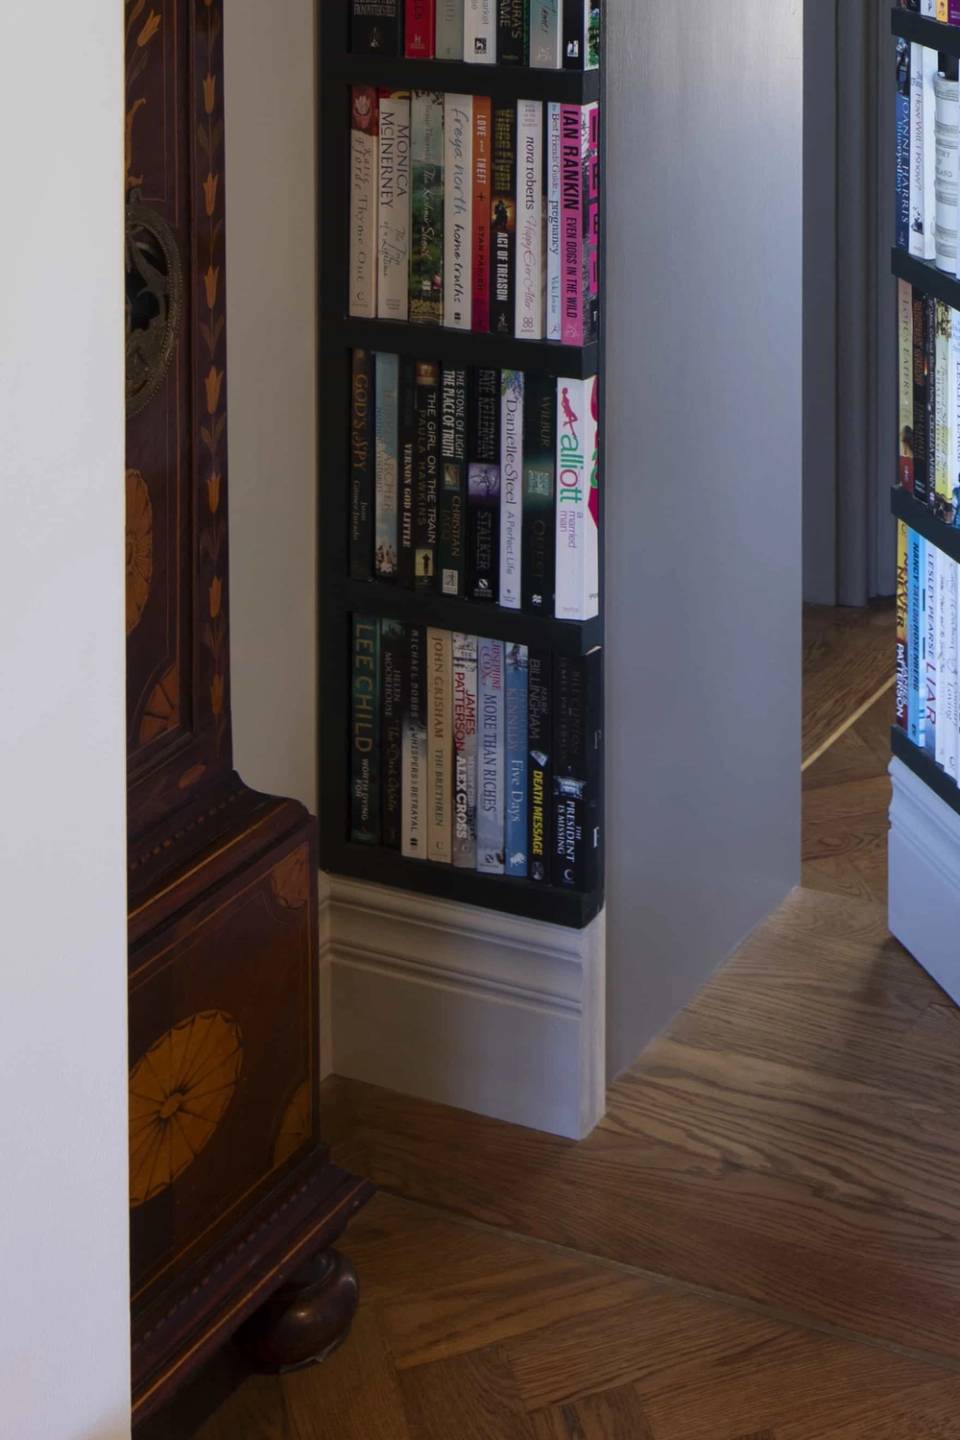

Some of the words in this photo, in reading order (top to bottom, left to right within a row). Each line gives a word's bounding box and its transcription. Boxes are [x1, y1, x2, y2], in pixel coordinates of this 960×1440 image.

[563, 110, 578, 138] IAN
[526, 136, 535, 164] nora
[526, 167, 535, 210] roberts
[563, 145, 579, 210] RANKIN
[497, 232, 507, 249] ACT
[567, 217, 577, 239] EVEN
[497, 251, 507, 262] OF
[567, 241, 577, 264] DOGS
[496, 264, 508, 301] TREASON
[567, 267, 577, 276] IN
[567, 279, 577, 294] THE
[567, 297, 577, 318] WILD
[560, 435, 583, 503] alliott
[484, 694, 496, 729] MORE
[484, 734, 496, 765] THAN
[483, 769, 496, 812] RICHES
[533, 770, 543, 804] DEATH
[533, 807, 542, 855] MESSAGE
